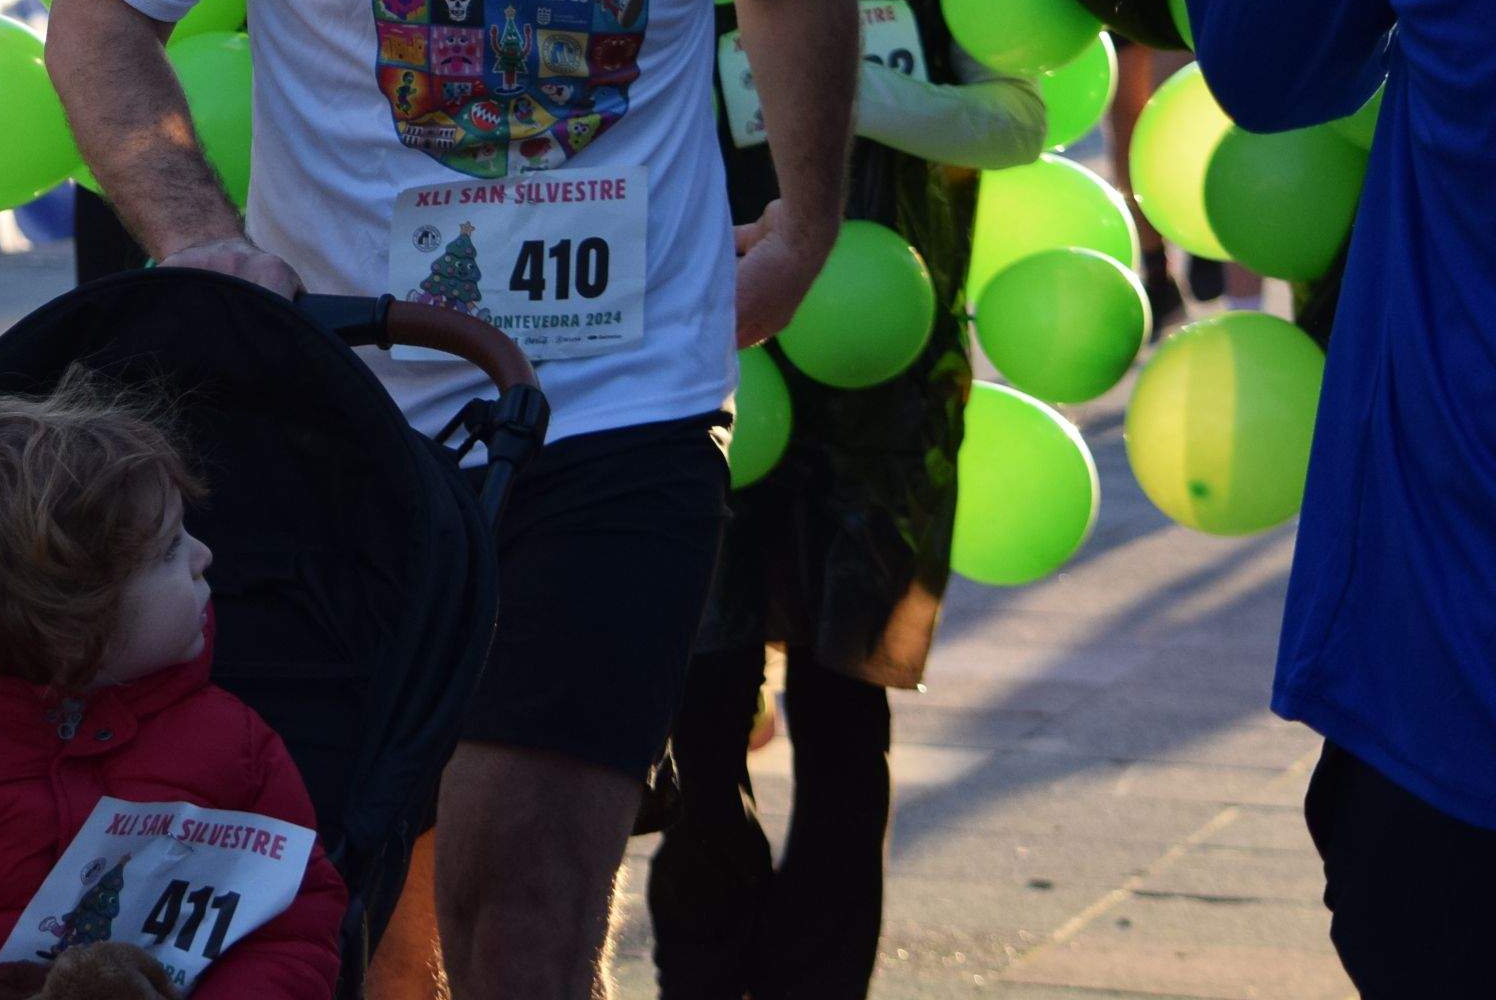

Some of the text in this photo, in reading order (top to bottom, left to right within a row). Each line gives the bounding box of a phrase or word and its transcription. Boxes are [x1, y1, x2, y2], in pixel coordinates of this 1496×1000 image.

[415, 178, 626, 207] XLI SAN SILVESTRE
[509, 236, 610, 301] 410
[586, 311, 622, 326] 2024
[105, 813, 287, 860] XLI SAN SILVESTRE
[141, 878, 241, 960] 411
